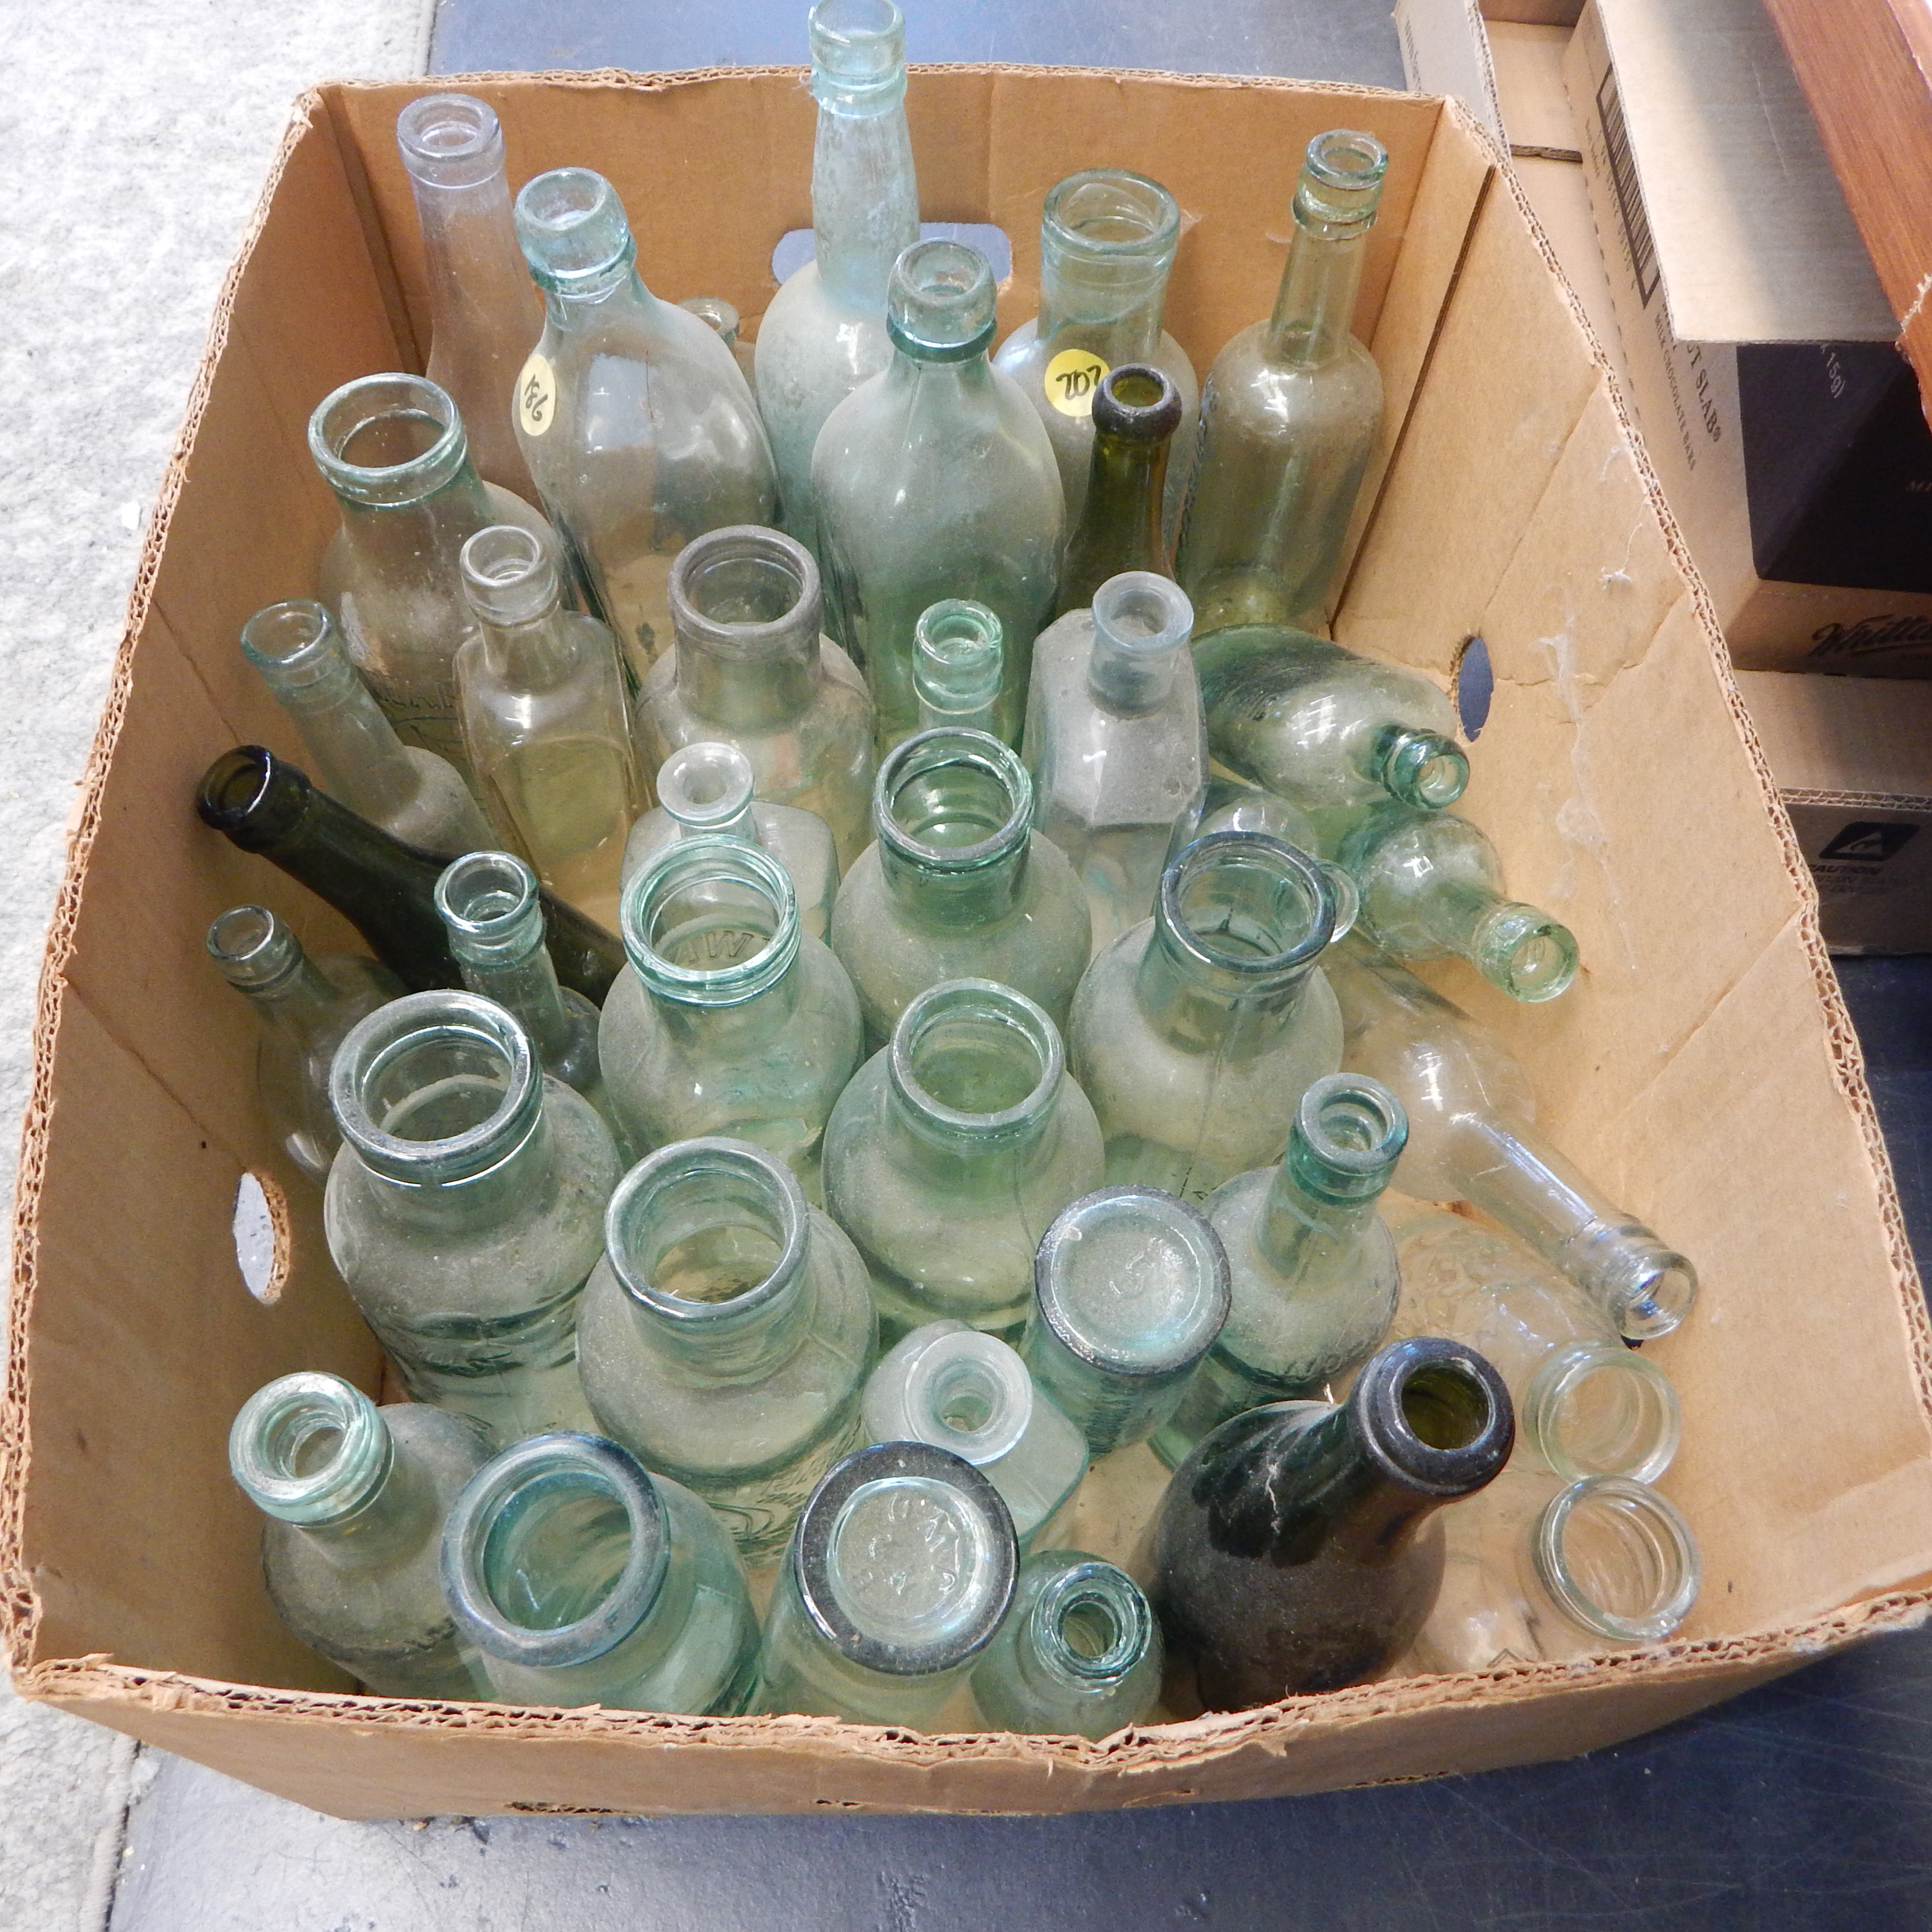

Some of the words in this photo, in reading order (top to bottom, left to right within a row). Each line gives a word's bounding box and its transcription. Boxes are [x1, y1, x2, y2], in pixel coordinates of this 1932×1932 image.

[1655, 313, 1666, 349] MILK
[1663, 349, 1686, 432] CHOCOLATE
[1683, 431, 1696, 470] BARS
